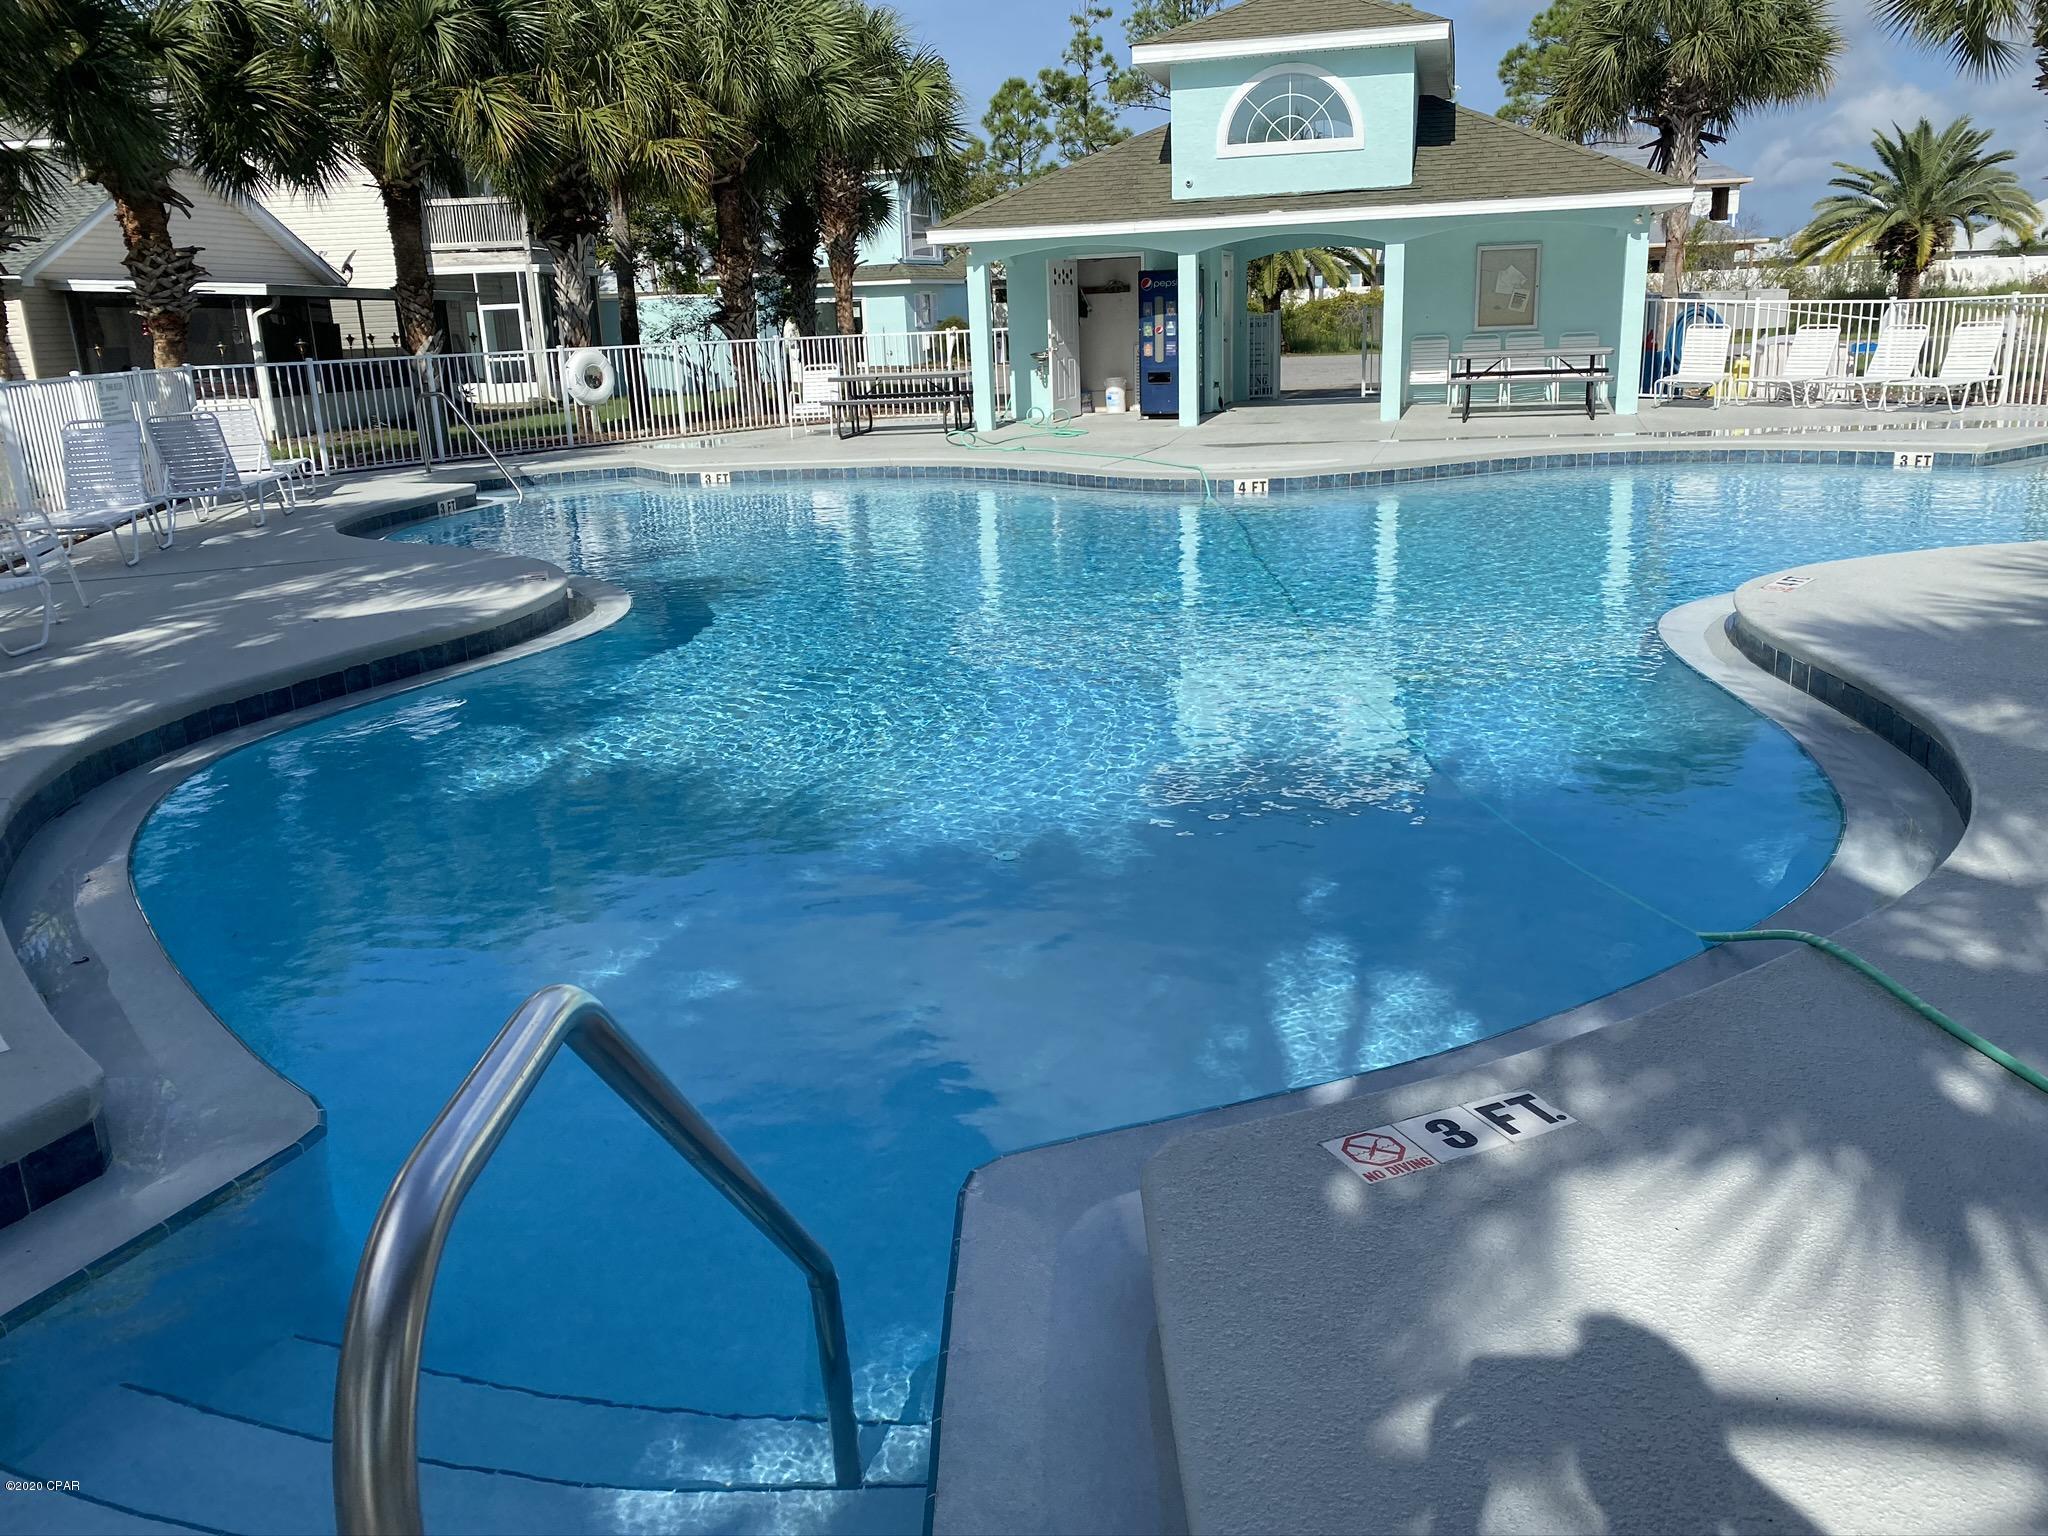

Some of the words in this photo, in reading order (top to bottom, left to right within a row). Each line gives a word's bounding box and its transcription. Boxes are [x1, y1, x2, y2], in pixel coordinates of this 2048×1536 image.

[1900, 454, 1908, 467] 3
[1915, 454, 1932, 468] FT
[705, 474, 712, 485] 3
[716, 473, 729, 484] FT
[1238, 481, 1246, 494] 4
[1252, 481, 1267, 493] FT
[1424, 1118, 1479, 1149] 3
[1362, 1169, 1387, 1182] NO
[1384, 1156, 1435, 1176] DIVING
